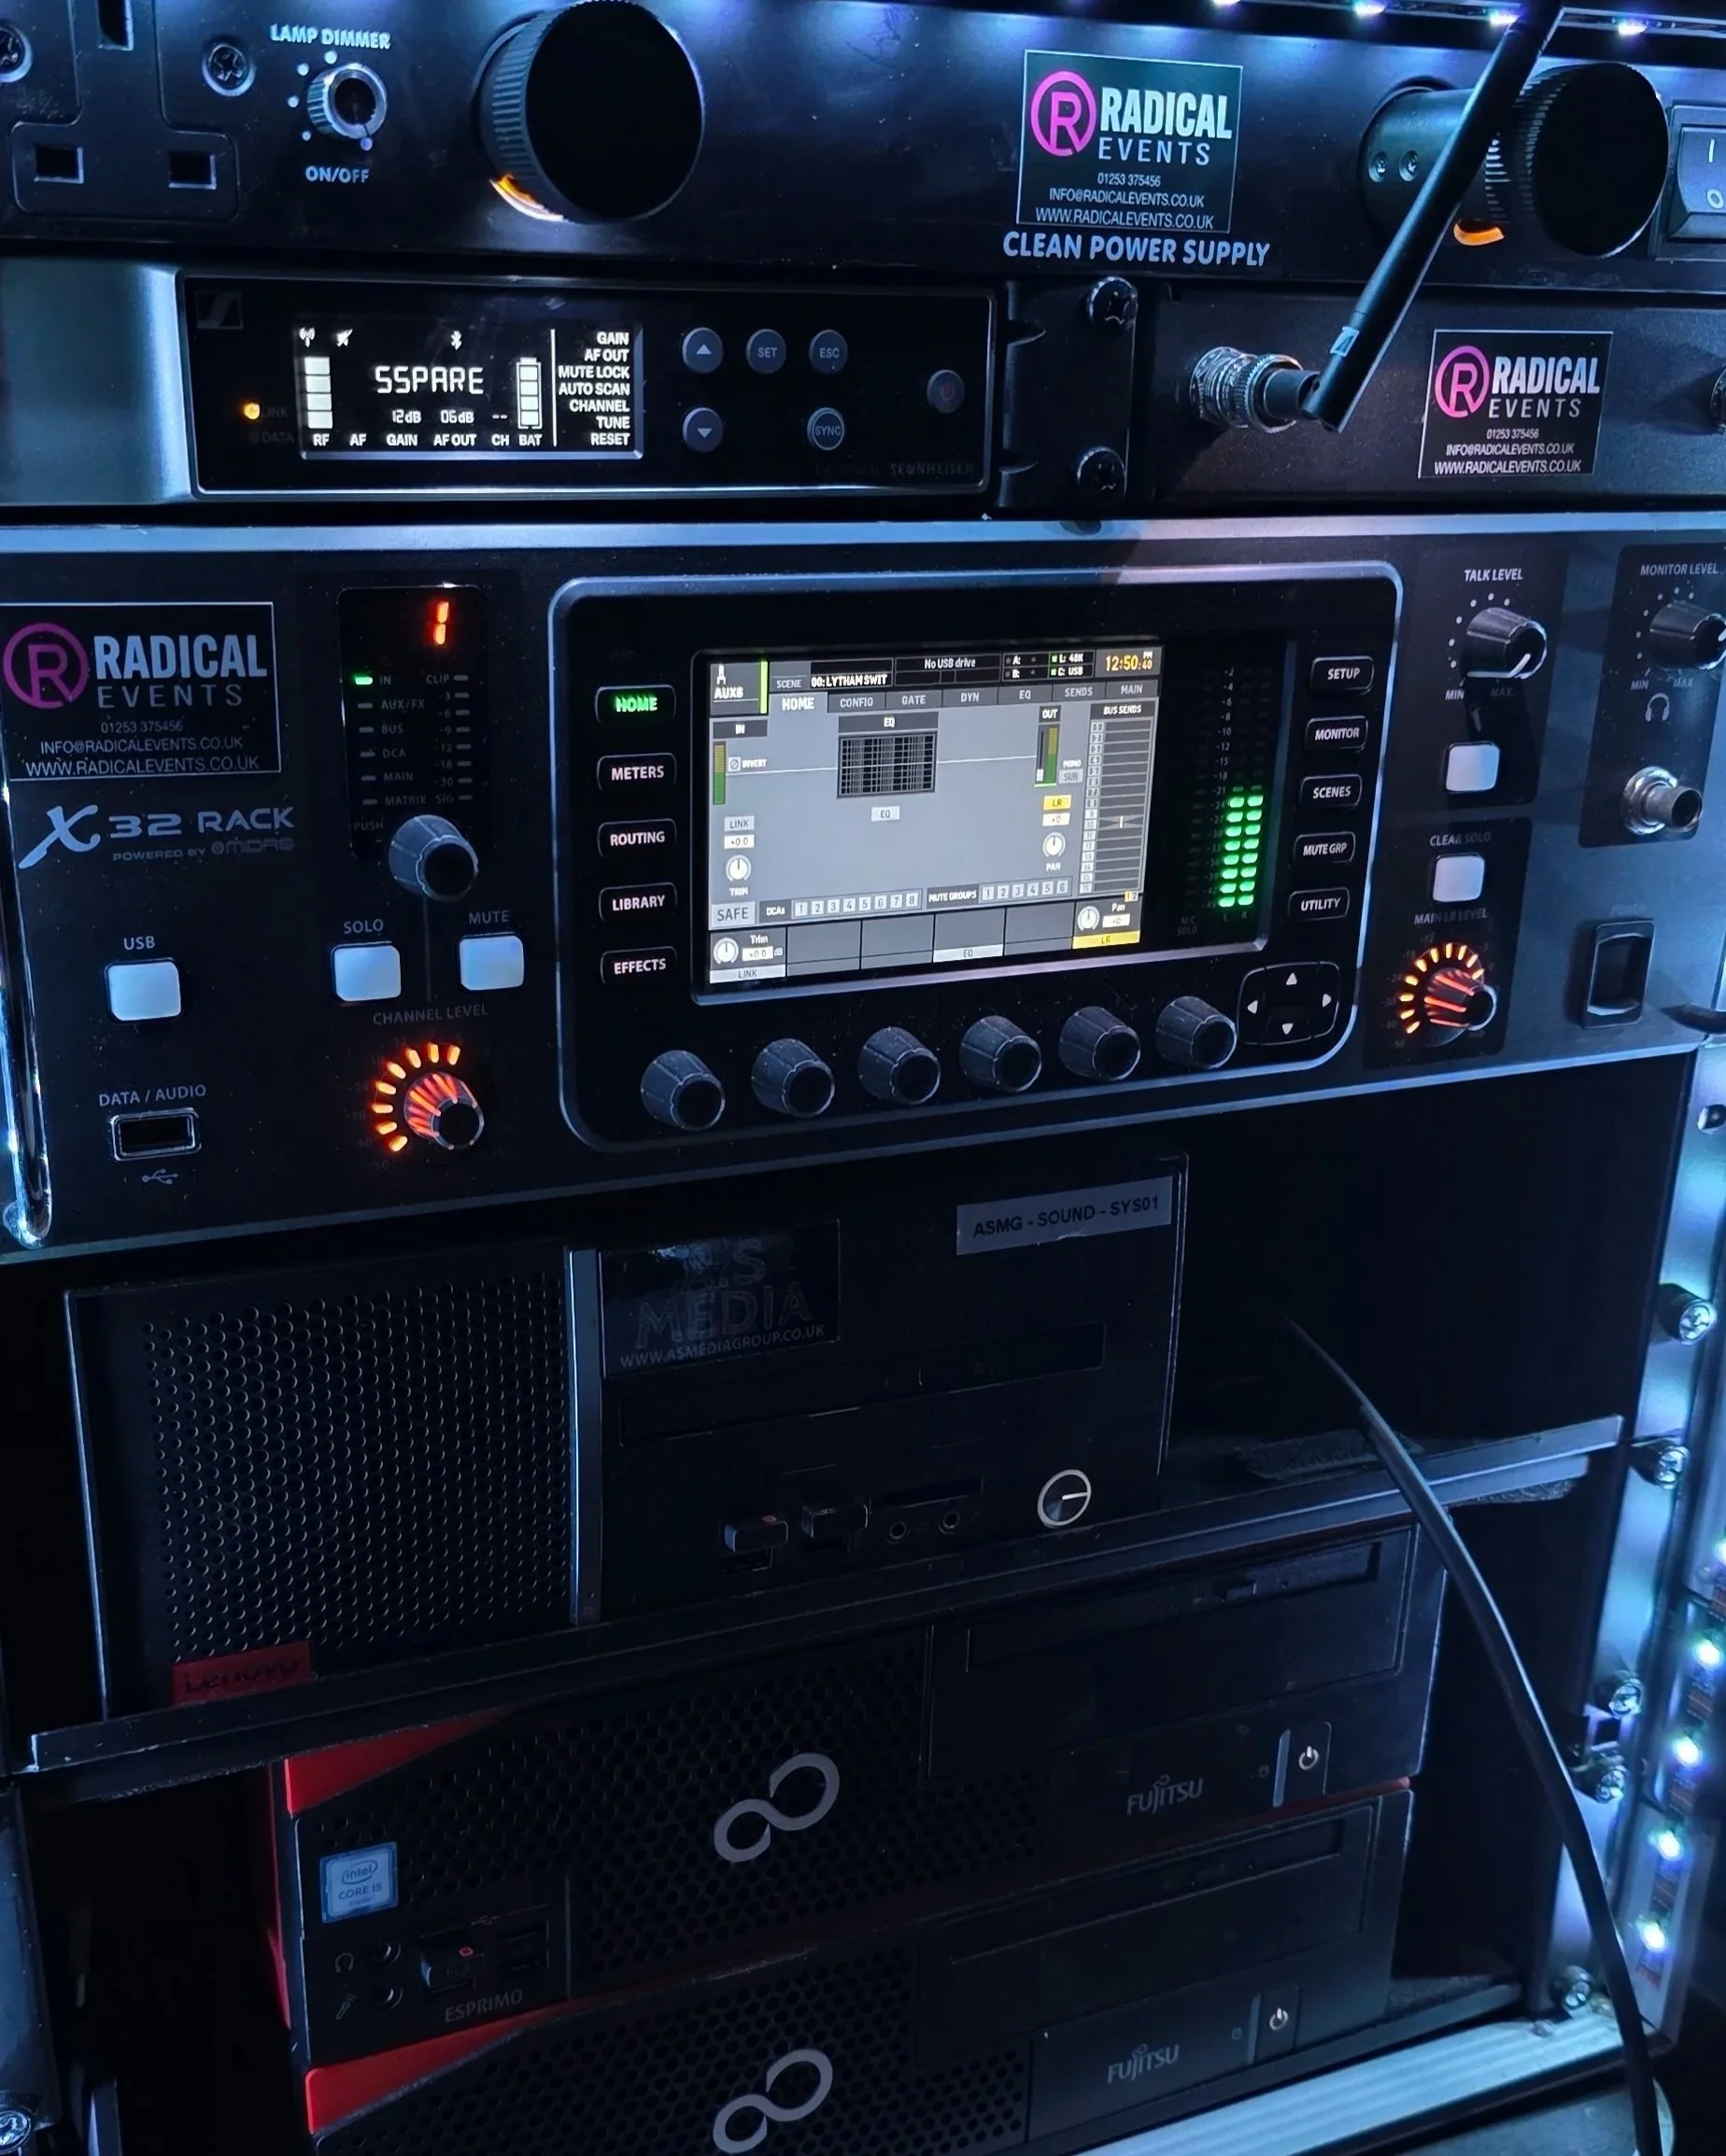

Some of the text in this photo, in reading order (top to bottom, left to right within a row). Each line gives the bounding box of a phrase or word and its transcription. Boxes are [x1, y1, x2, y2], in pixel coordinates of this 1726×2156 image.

[270, 23, 391, 49] LAMP DIMMER
[1099, 87, 1232, 139] RADICAL
[1098, 137, 1210, 166] EVENTS
[305, 165, 370, 183] ON/OFF
[1097, 172, 1161, 188] 01253 375456
[1049, 188, 1205, 208] INFO@RADICALEVENTS.CO.UK
[1035, 207, 1215, 230] WWW.RADICALEVENTS.CO.UK
[1003, 232, 1270, 267] CLEAN POWER SUPPLY
[597, 332, 629, 345] GAIN
[585, 348, 629, 362] AF OUT
[757, 346, 777, 359] SET
[819, 346, 840, 359] ESC
[559, 366, 630, 379] MUTE LOCK
[1492, 356, 1600, 395] RADICAL
[559, 383, 630, 396] AUTO SCAN
[570, 399, 630, 412] CHANNEL
[1489, 399, 1581, 419] EVENTS
[597, 416, 630, 430] TUNE
[814, 426, 842, 437] SYNC
[1486, 429, 1539, 440] 01253 375456
[313, 433, 330, 446] RF
[349, 433, 366, 446] AF
[386, 433, 417, 446] GAIN
[433, 433, 476, 446] AF OUT
[491, 433, 510, 446] CH
[519, 433, 542, 446] BAT
[591, 432, 630, 445] RESET
[1446, 444, 1574, 457] INFO@RADICALEVENTS.CO.UK
[1435, 459, 1582, 475] WWW.RADICALEVENTS.CO.UK
[1464, 568, 1523, 582] TALK LEVEL
[1640, 563, 1719, 576] MONITOR LEVEL
[93, 634, 268, 680] RADICAL
[924, 657, 976, 669] No USB drive
[379, 676, 392, 685] IN
[426, 675, 449, 685] CLIP
[1327, 668, 1360, 680] SETUP
[776, 680, 801, 689] SCENE
[1121, 684, 1142, 695] MAIN
[1631, 680, 1649, 691] MIN
[1673, 677, 1693, 689] MAX
[97, 683, 242, 709] EVENTS
[960, 692, 980, 702] DYN
[1019, 690, 1031, 700] EQ
[1064, 686, 1093, 698] SENDS
[1445, 689, 1464, 700] MIN
[1491, 686, 1513, 698] MAX
[381, 698, 426, 710] AUX/FX
[615, 695, 658, 712] HOME
[782, 698, 815, 711] HOME
[840, 697, 874, 708] CONFIG
[901, 695, 927, 705] GATE
[1042, 709, 1057, 719] OUT
[1103, 705, 1141, 715] BUS SENDS
[101, 720, 183, 734] 01253 375456
[884, 717, 896, 727] EQ
[381, 725, 403, 735] BUS
[1315, 727, 1360, 740] MONITOR
[40, 737, 243, 754] INFO@RADICALEVENTS.CO.UK
[382, 748, 406, 759] DCA
[25, 755, 260, 777] WWW.RADICALEVENTS.CO.UK
[383, 772, 414, 782] MAIN
[612, 766, 665, 782] METERS
[1312, 785, 1351, 798] SCENES
[385, 796, 427, 807] MATRIX
[197, 807, 295, 834] RACK
[880, 810, 890, 819] EQ
[353, 818, 384, 831] PUSH
[729, 820, 749, 829] LINK
[610, 831, 665, 847] ROUTING
[1429, 831, 1492, 847] CLEAR SOLO
[113, 848, 183, 861] POWERED
[188, 847, 205, 858] BY
[1303, 842, 1347, 856] MUTE GRP
[613, 895, 665, 911] LIBRARY
[1301, 897, 1340, 911] UTILITY
[468, 909, 509, 925] MUTE
[716, 907, 749, 922] SAFE
[1414, 911, 1442, 925] MAIN
[1458, 908, 1488, 921] LEVEL
[344, 918, 384, 935] SOLO
[122, 935, 156, 951] USB
[963, 949, 973, 957] EQ
[615, 958, 667, 975] EFFECTS
[738, 969, 757, 979] LINK
[374, 1003, 489, 1025] CHANNEL LEVEL
[98, 1091, 143, 1107] DATA
[154, 1083, 207, 1102] AUDIO
[973, 1216, 1023, 1238] ASMG
[1037, 1205, 1096, 1227] SOUND
[1110, 1195, 1158, 1217] SYS01
[636, 1280, 813, 1350] MEDIA
[619, 1323, 827, 1369] WWW.ASMEDIAGROUP.CO.UK
[1126, 1774, 1204, 1815] FUJITSU
[347, 1864, 373, 1880] intel
[338, 1885, 370, 1900] CORE
[445, 1988, 523, 2024] ESPRIMO
[1108, 2043, 1181, 2084] FUJITSU
